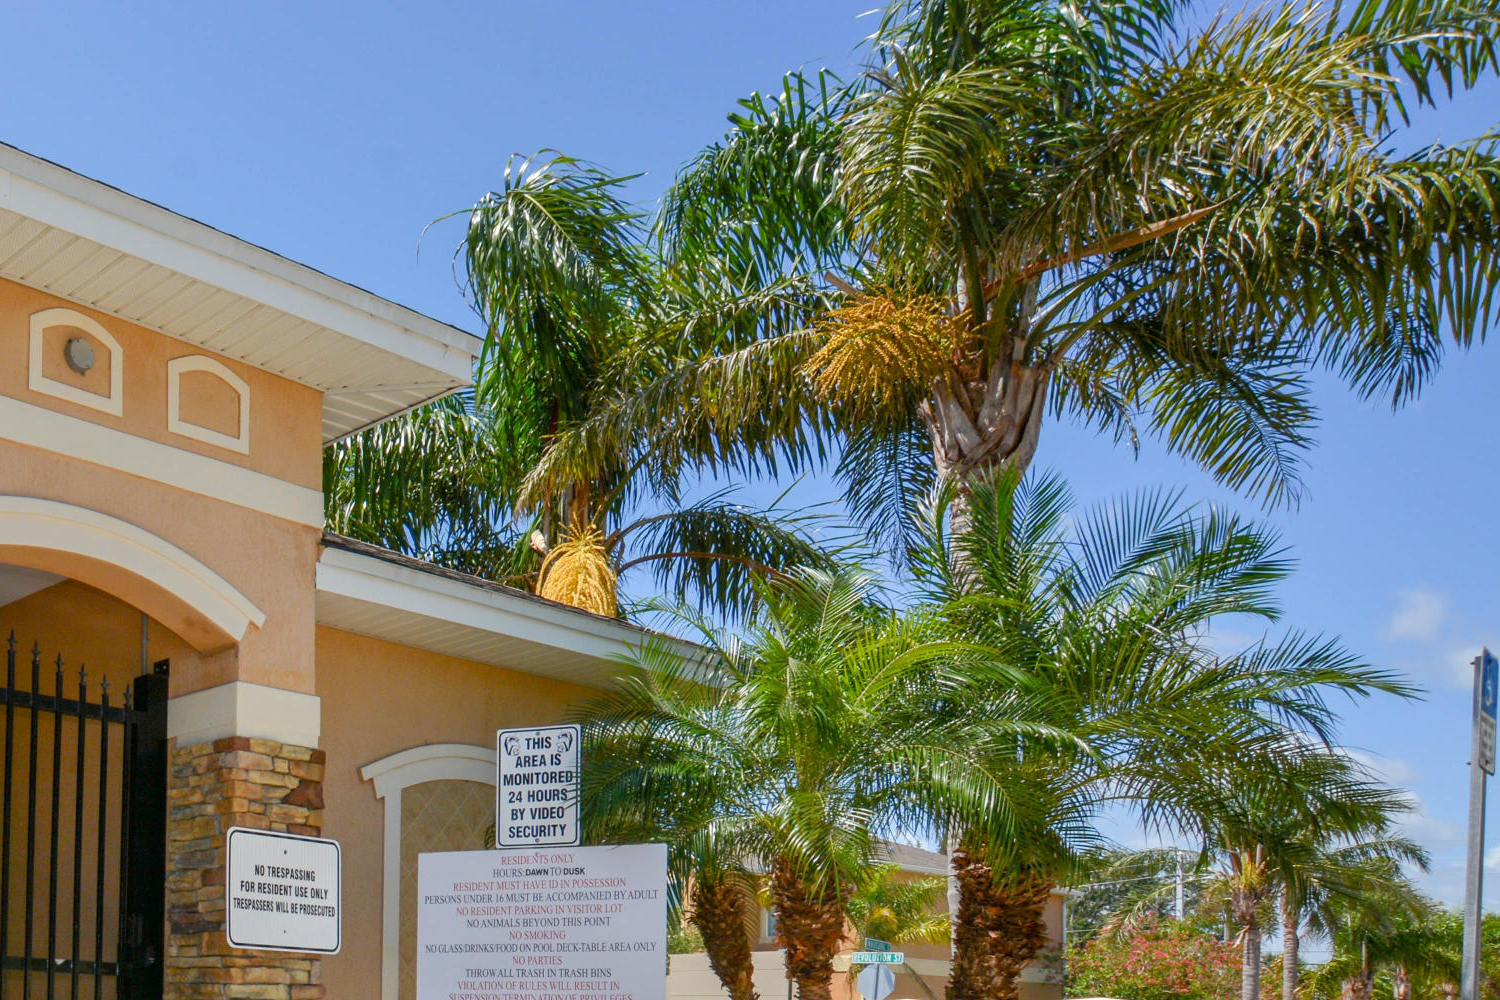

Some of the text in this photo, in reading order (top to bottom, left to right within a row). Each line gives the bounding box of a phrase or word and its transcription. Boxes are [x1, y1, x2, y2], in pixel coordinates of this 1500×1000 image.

[525, 736, 552, 750] THIS
[515, 753, 561, 768] AREA IS
[503, 771, 573, 786] MONITORED
[508, 788, 568, 804] 24 HOURS
[511, 806, 565, 820] BY VIDEO
[508, 824, 566, 839] SECURITY
[501, 853, 575, 866] RESIDENTS ONLY
[254, 864, 315, 882] NO TRESPASSING
[525, 868, 549, 877] DAWN
[550, 867, 562, 877] TO
[563, 867, 585, 875] DUSK
[240, 880, 328, 900] FOR RESIDENT USE ONLY
[453, 878, 627, 892] RESIDENT MUST HAVE ID IN POSSESSION
[424, 890, 659, 905] PERSONS UNDER 16 MUST BE ACCOMPANIED BY ADULT
[233, 897, 336, 918] TRESPASSERS WILL BE PROSECUTED
[456, 903, 624, 916] NO RESIDENT PARKING IN VISITOR LOT
[466, 917, 612, 928] NO ANIMALS BEYOND THIS POINT
[509, 930, 566, 940] NO SMOKING
[425, 944, 437, 953] NO
[519, 943, 532, 953] ON
[533, 943, 554, 953] POOL
[609, 942, 632, 952] AREA
[633, 941, 657, 952] ONLY
[512, 955, 563, 965] NO PARTIES
[465, 968, 612, 978] THROW ALL TRASH IN TRASH BINS
[457, 981, 620, 991] VIOLATION OF RULES WILL RESULT IN
